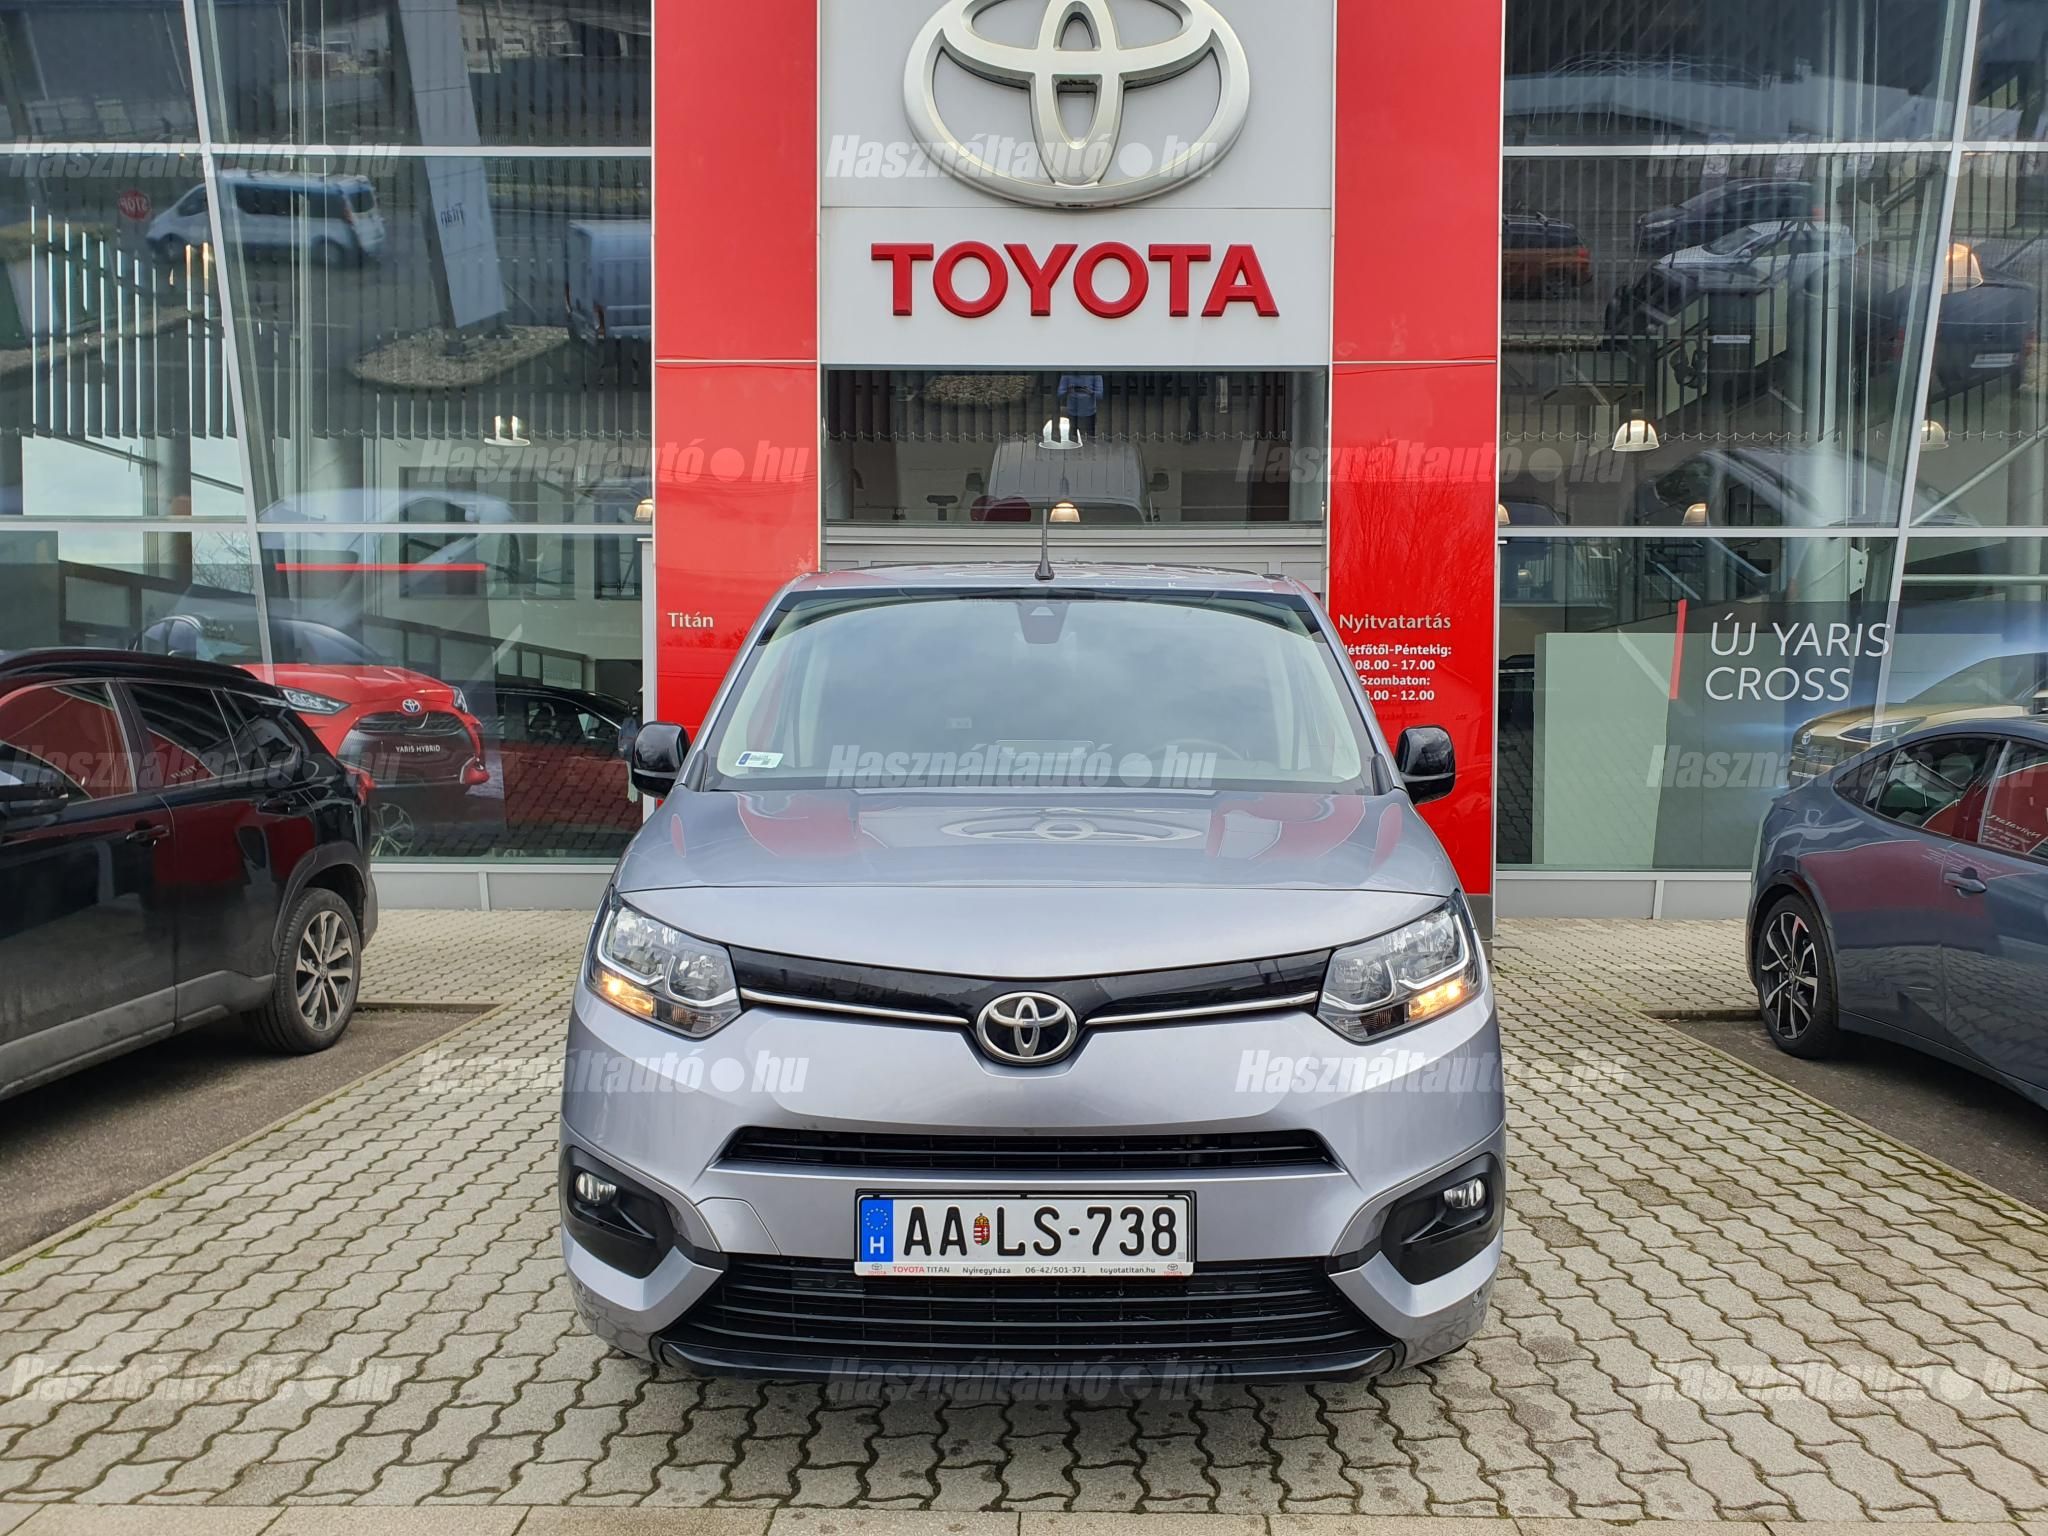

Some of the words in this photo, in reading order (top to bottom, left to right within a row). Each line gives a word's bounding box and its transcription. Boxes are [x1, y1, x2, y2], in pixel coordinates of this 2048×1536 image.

[871, 241, 1279, 319] TOYOTA
[667, 612, 714, 628] Titán
[1339, 612, 1452, 634] Nyitvatartás
[1711, 612, 1757, 656] ÚJ
[1772, 622, 1890, 657] YARIS
[1354, 659, 1390, 671] 08.00
[1401, 659, 1436, 671] 17.00
[1360, 674, 1431, 686] Szombaton:
[1705, 666, 1851, 702] CROSS
[1400, 690, 1435, 701] 12.00
[997, 1206, 1177, 1257] LS-738
[870, 1236, 885, 1254] H
[892, 1265, 925, 1273] TOYOTA
